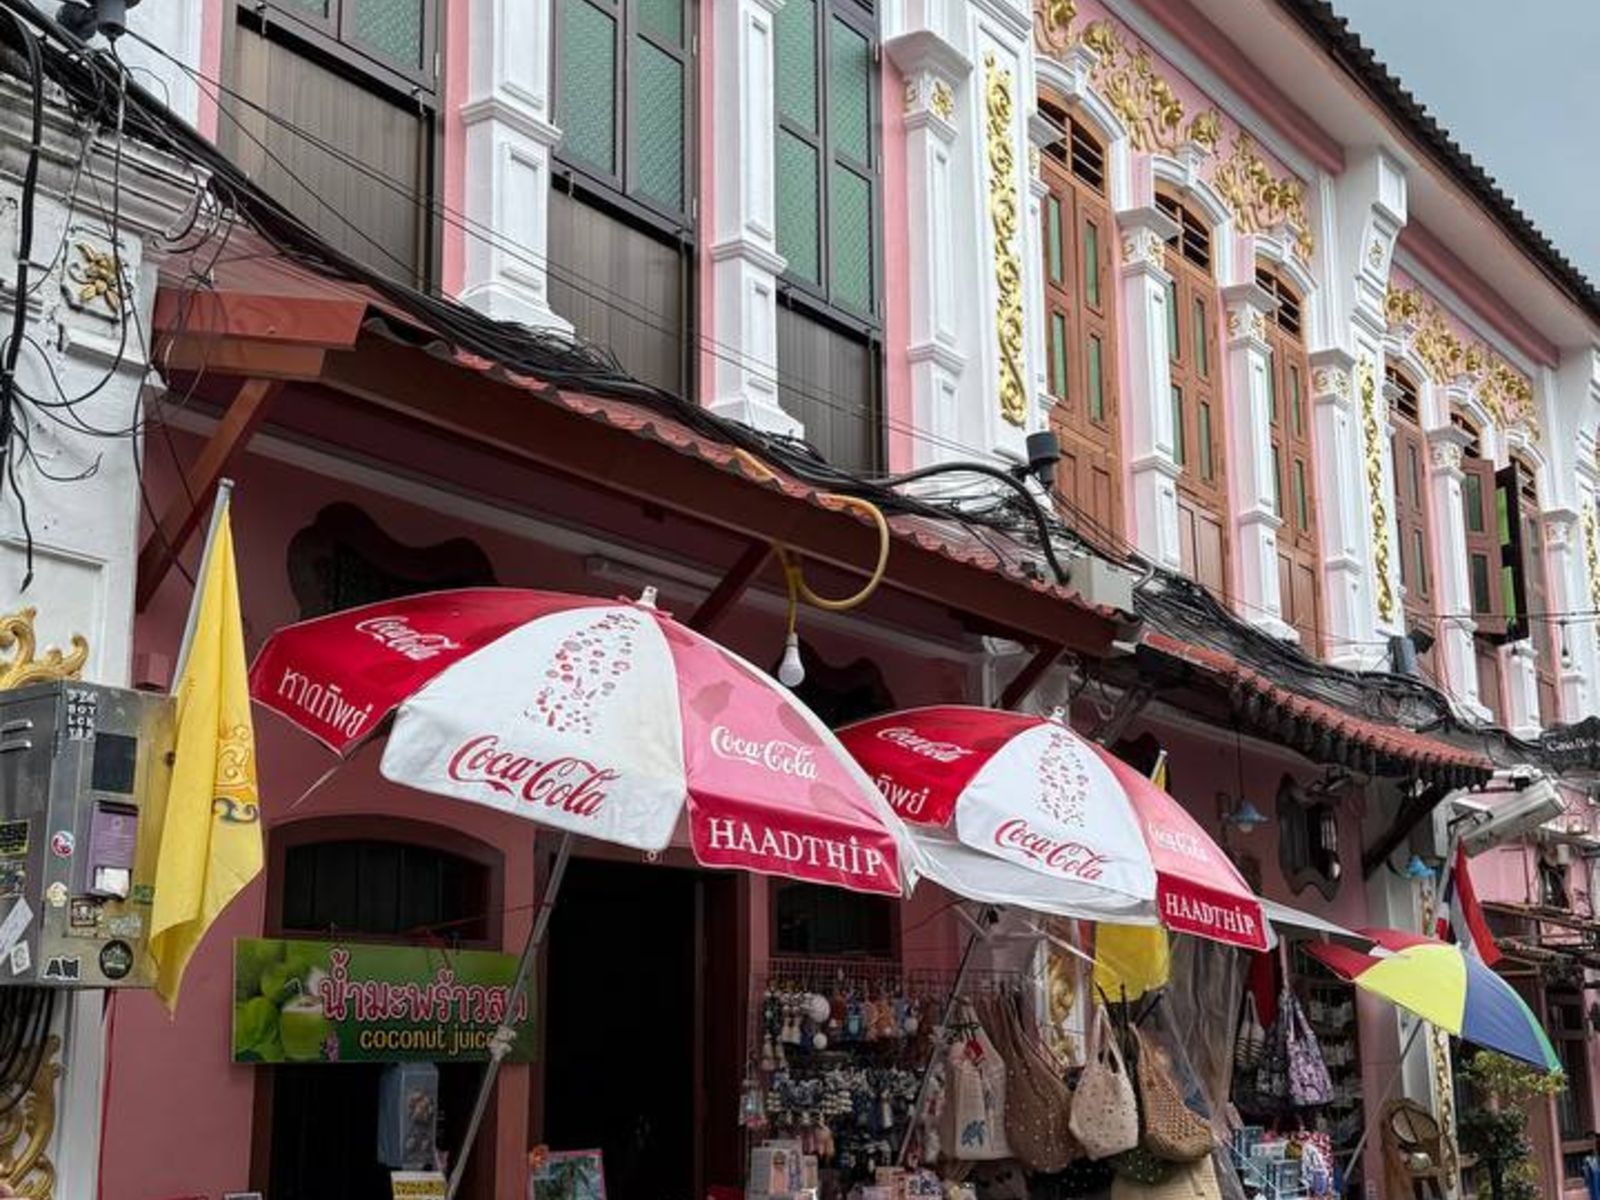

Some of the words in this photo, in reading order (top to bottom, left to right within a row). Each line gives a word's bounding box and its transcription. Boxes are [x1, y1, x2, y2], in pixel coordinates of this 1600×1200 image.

[447, 734, 623, 817] Coca-Cola
[710, 725, 819, 780] Coca-Cola
[359, 1023, 448, 1051] coconut
